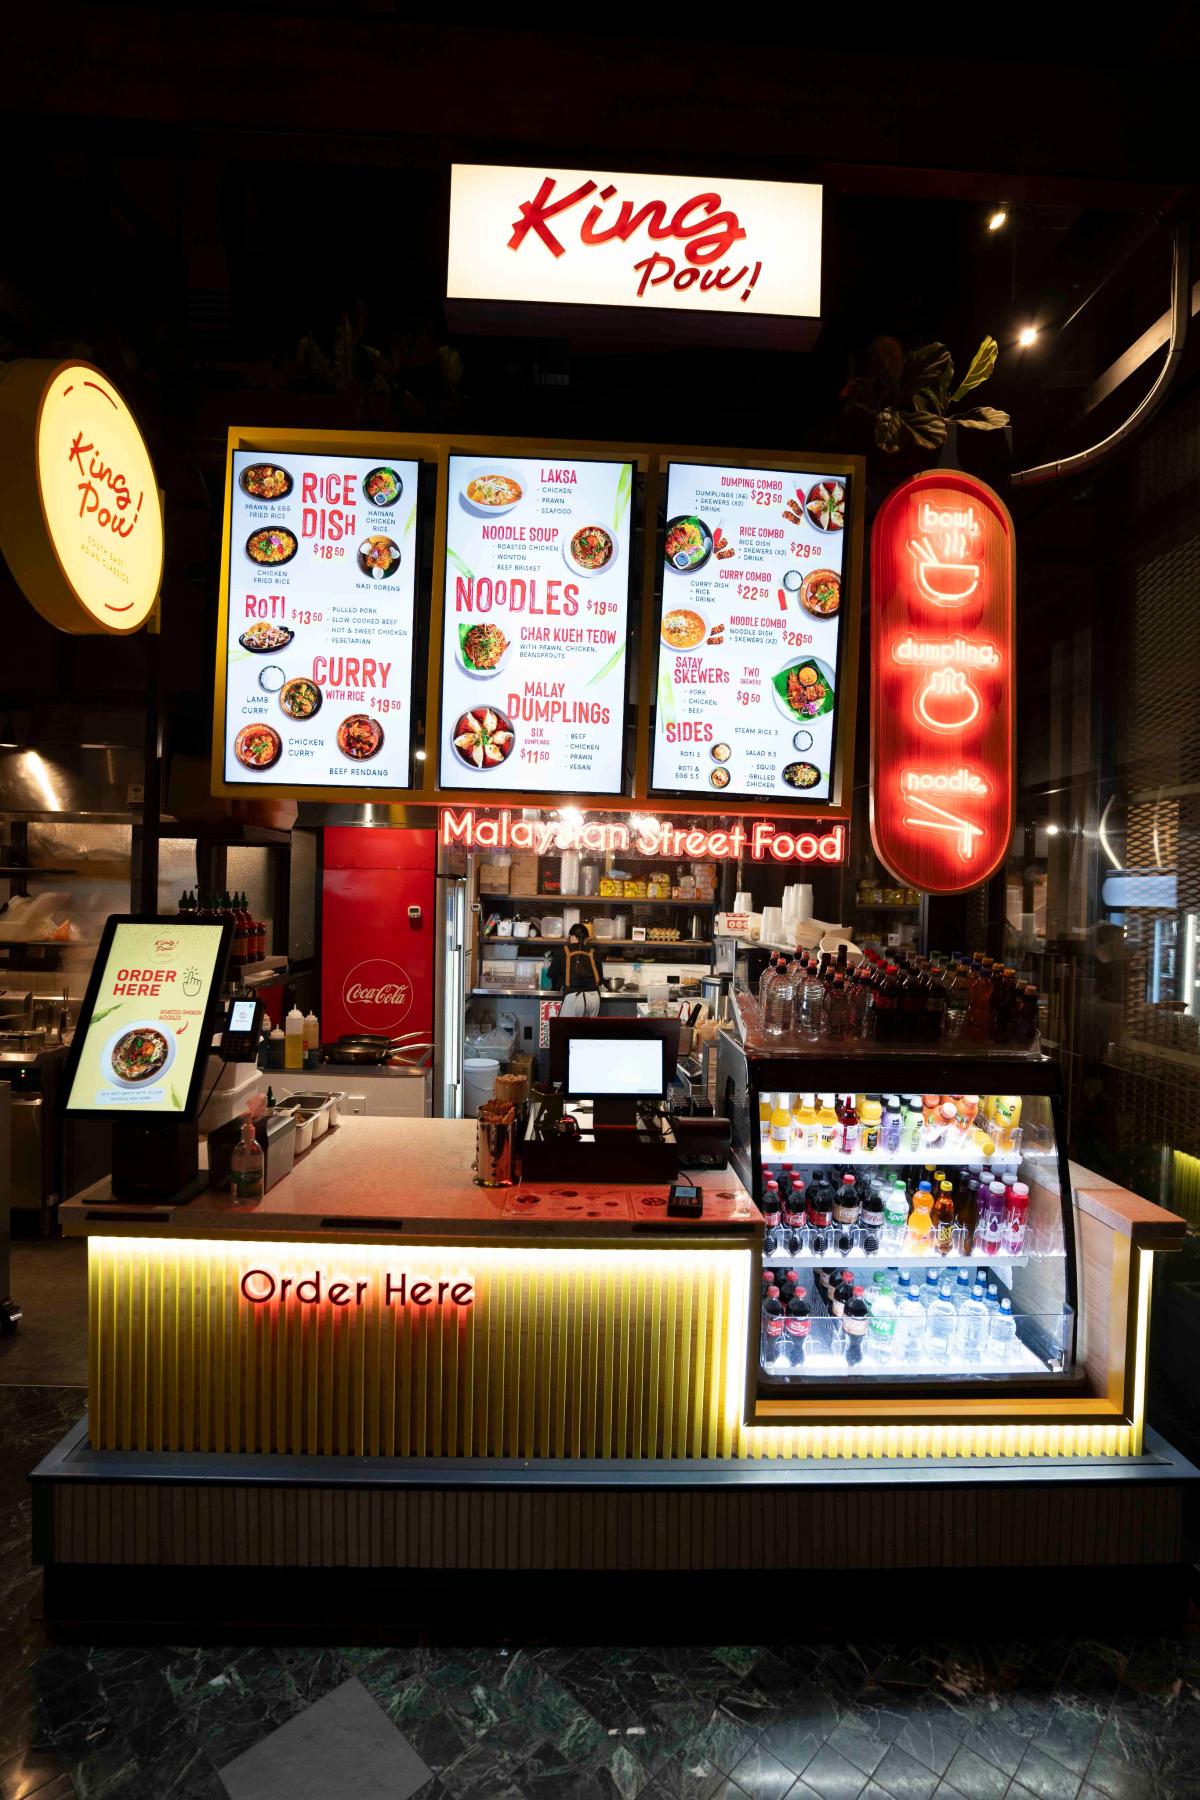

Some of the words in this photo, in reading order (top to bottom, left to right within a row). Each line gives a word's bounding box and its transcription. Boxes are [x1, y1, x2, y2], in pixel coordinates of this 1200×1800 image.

[507, 176, 746, 265] King
[634, 251, 762, 302] Pow!
[69, 431, 132, 510] King
[541, 469, 577, 484] LAKSA
[302, 472, 357, 506] RICE
[721, 476, 755, 489] DUMPING
[757, 478, 783, 491] COMBO
[695, 490, 734, 499] DUMPLINGS
[78, 480, 144, 538] Pow!
[700, 498, 730, 506] SKEWERS
[542, 507, 571, 515] SEAFOOD
[302, 508, 355, 541] DISH
[482, 525, 526, 541] NOODLE
[529, 527, 559, 542] SOUP
[739, 526, 756, 537] RICE
[758, 528, 784, 539] COMBO
[743, 547, 773, 555] SKEWERS
[720, 569, 744, 581] CURRY
[746, 570, 772, 583] COMBO
[373, 584, 401, 592] GORENG
[690, 580, 712, 588] CURRY
[456, 576, 579, 616] NOODLES
[730, 616, 759, 627] NOODLE
[761, 617, 787, 629] COMBO
[521, 627, 550, 642] CHAR
[554, 628, 583, 643] KUEH
[587, 630, 616, 644] TEOW
[730, 628, 756, 636] NOODLE
[676, 656, 703, 670] SATAY
[312, 656, 392, 688] CURRY
[743, 667, 760, 678] TWO
[326, 690, 345, 701] WITH
[347, 690, 365, 702] RICE
[525, 682, 565, 698] MALAY
[688, 698, 718, 706] CHICKEN
[531, 728, 544, 737] SIX
[666, 721, 713, 743] SIDES
[288, 738, 324, 746] CHICKEN
[638, 818, 745, 858] Street
[752, 824, 843, 861] Food
[117, 970, 177, 982] ORDER
[113, 984, 160, 996] HERE
[346, 983, 410, 1004] Coca-Cola
[241, 1269, 367, 1306] Order
[386, 1273, 473, 1306] Here
